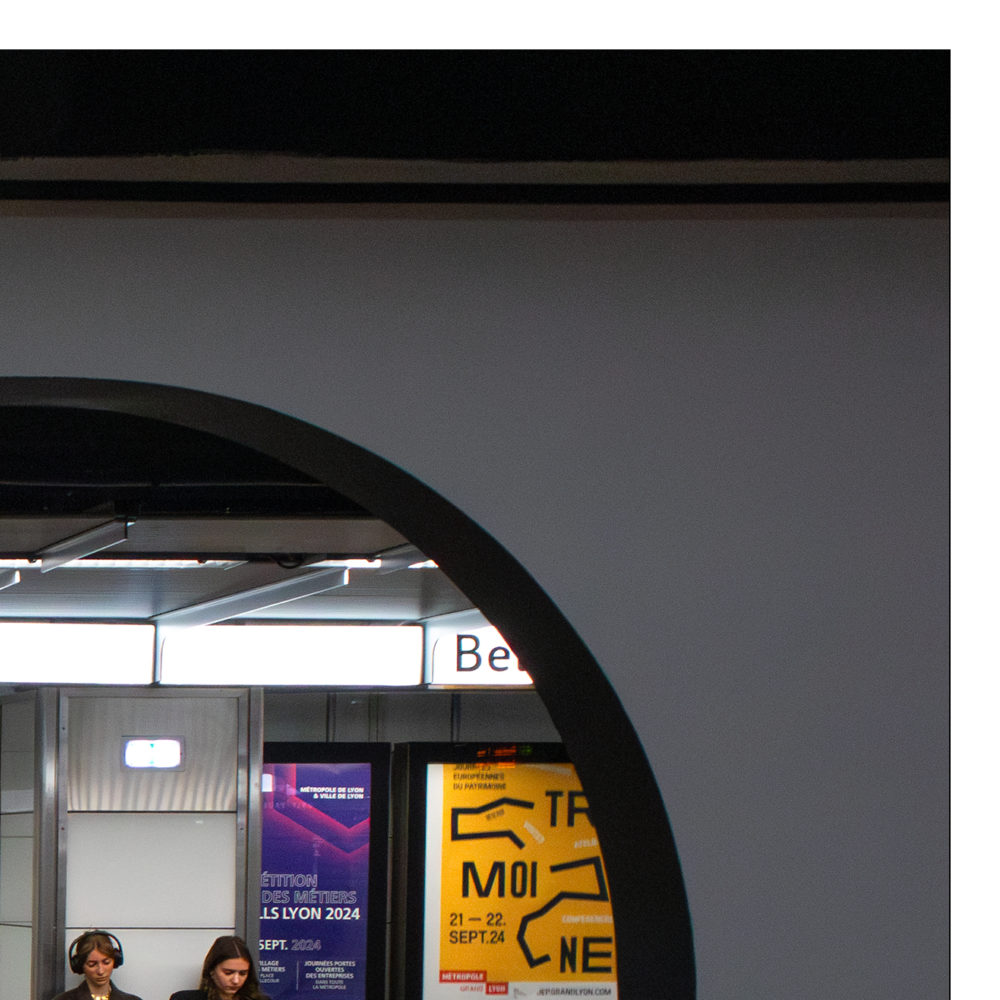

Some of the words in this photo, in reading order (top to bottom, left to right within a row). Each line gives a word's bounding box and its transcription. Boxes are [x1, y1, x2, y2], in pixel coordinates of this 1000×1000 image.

[260, 870, 318, 887] ÉTITION
[462, 861, 538, 898] MOI
[261, 890, 290, 904] DES
[293, 888, 357, 904] MÉTIERS
[282, 907, 321, 920] LYON
[325, 907, 361, 920] 2024
[450, 913, 463, 926] 21
[486, 913, 506, 926] 22.
[449, 930, 505, 944] SEPT.24
[258, 939, 288, 950] SEPT.
[291, 939, 322, 951] 2024
[560, 936, 613, 973] NE
[488, 984, 506, 993] LYON
